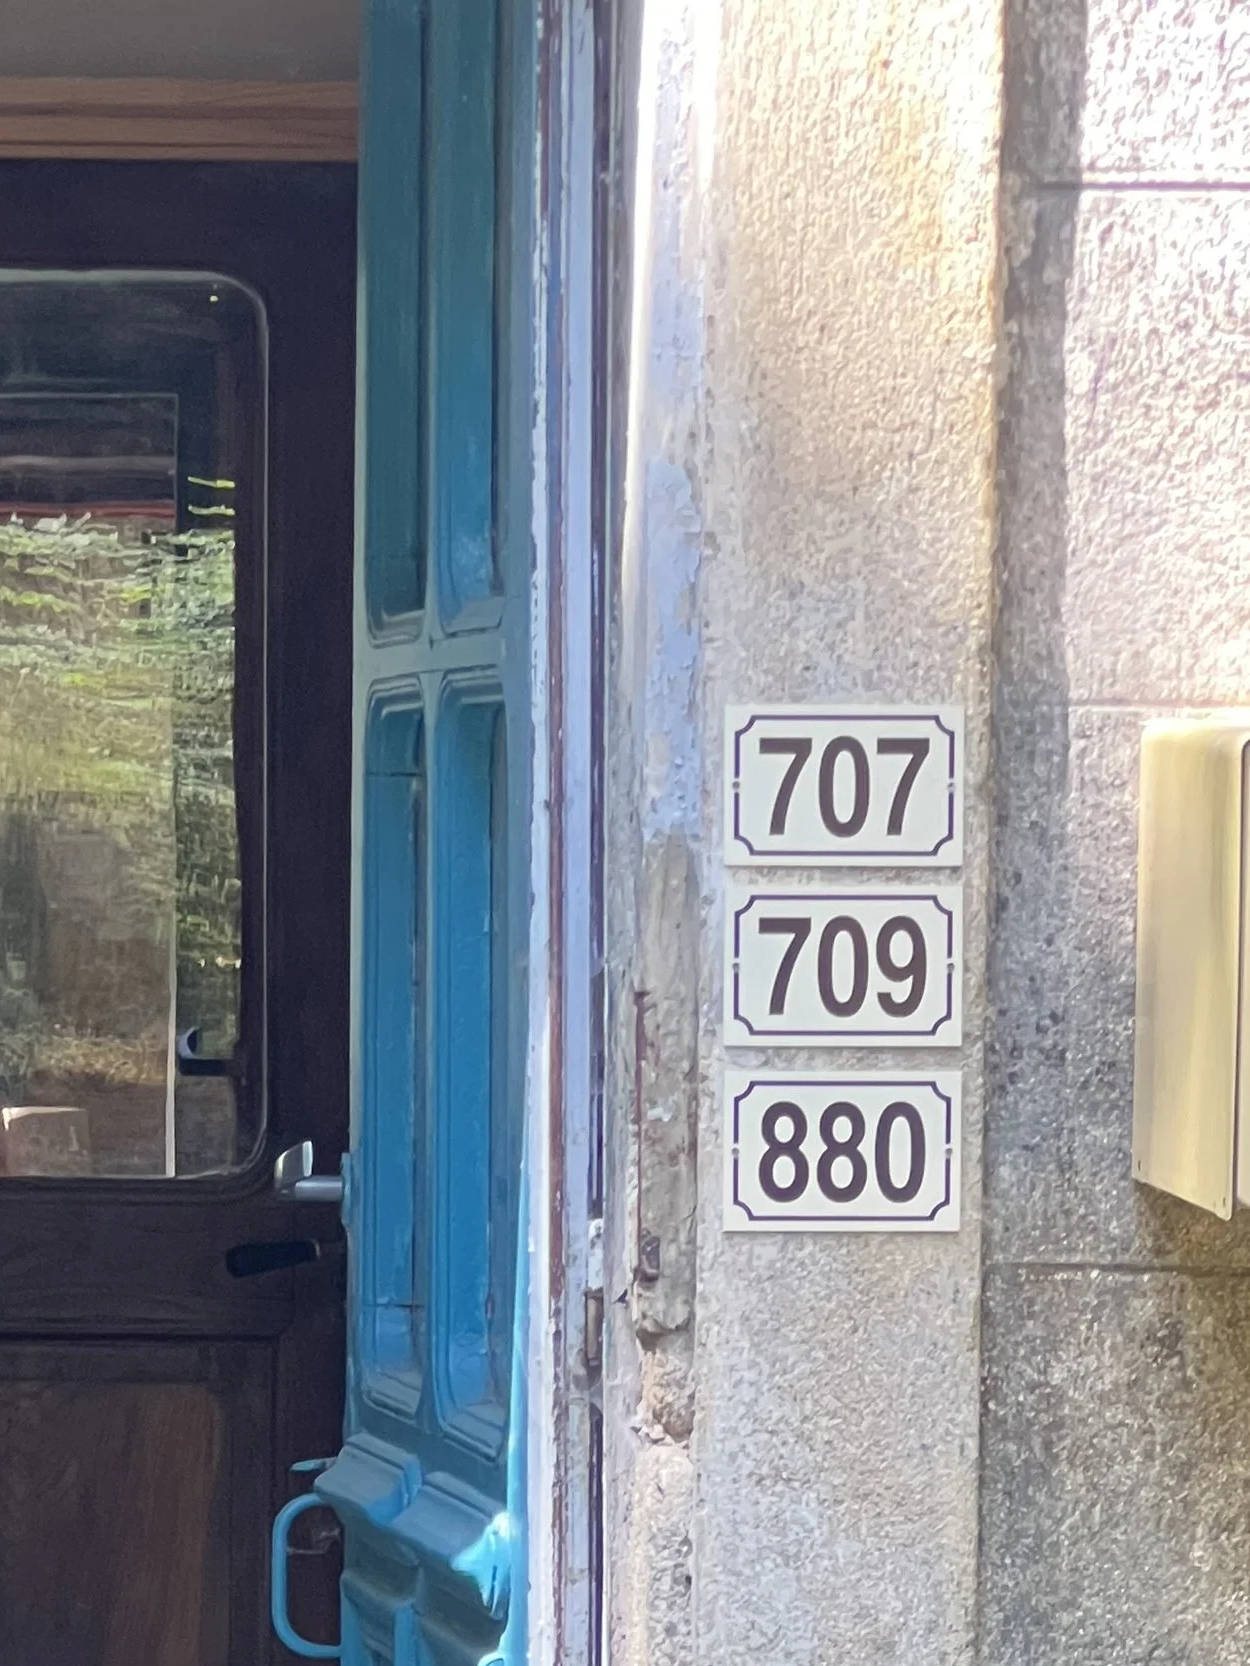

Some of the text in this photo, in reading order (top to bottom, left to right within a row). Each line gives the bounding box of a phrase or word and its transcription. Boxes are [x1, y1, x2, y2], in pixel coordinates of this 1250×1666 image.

[758, 736, 931, 838] 707
[758, 916, 928, 1018] 709
[758, 1101, 926, 1203] 880
